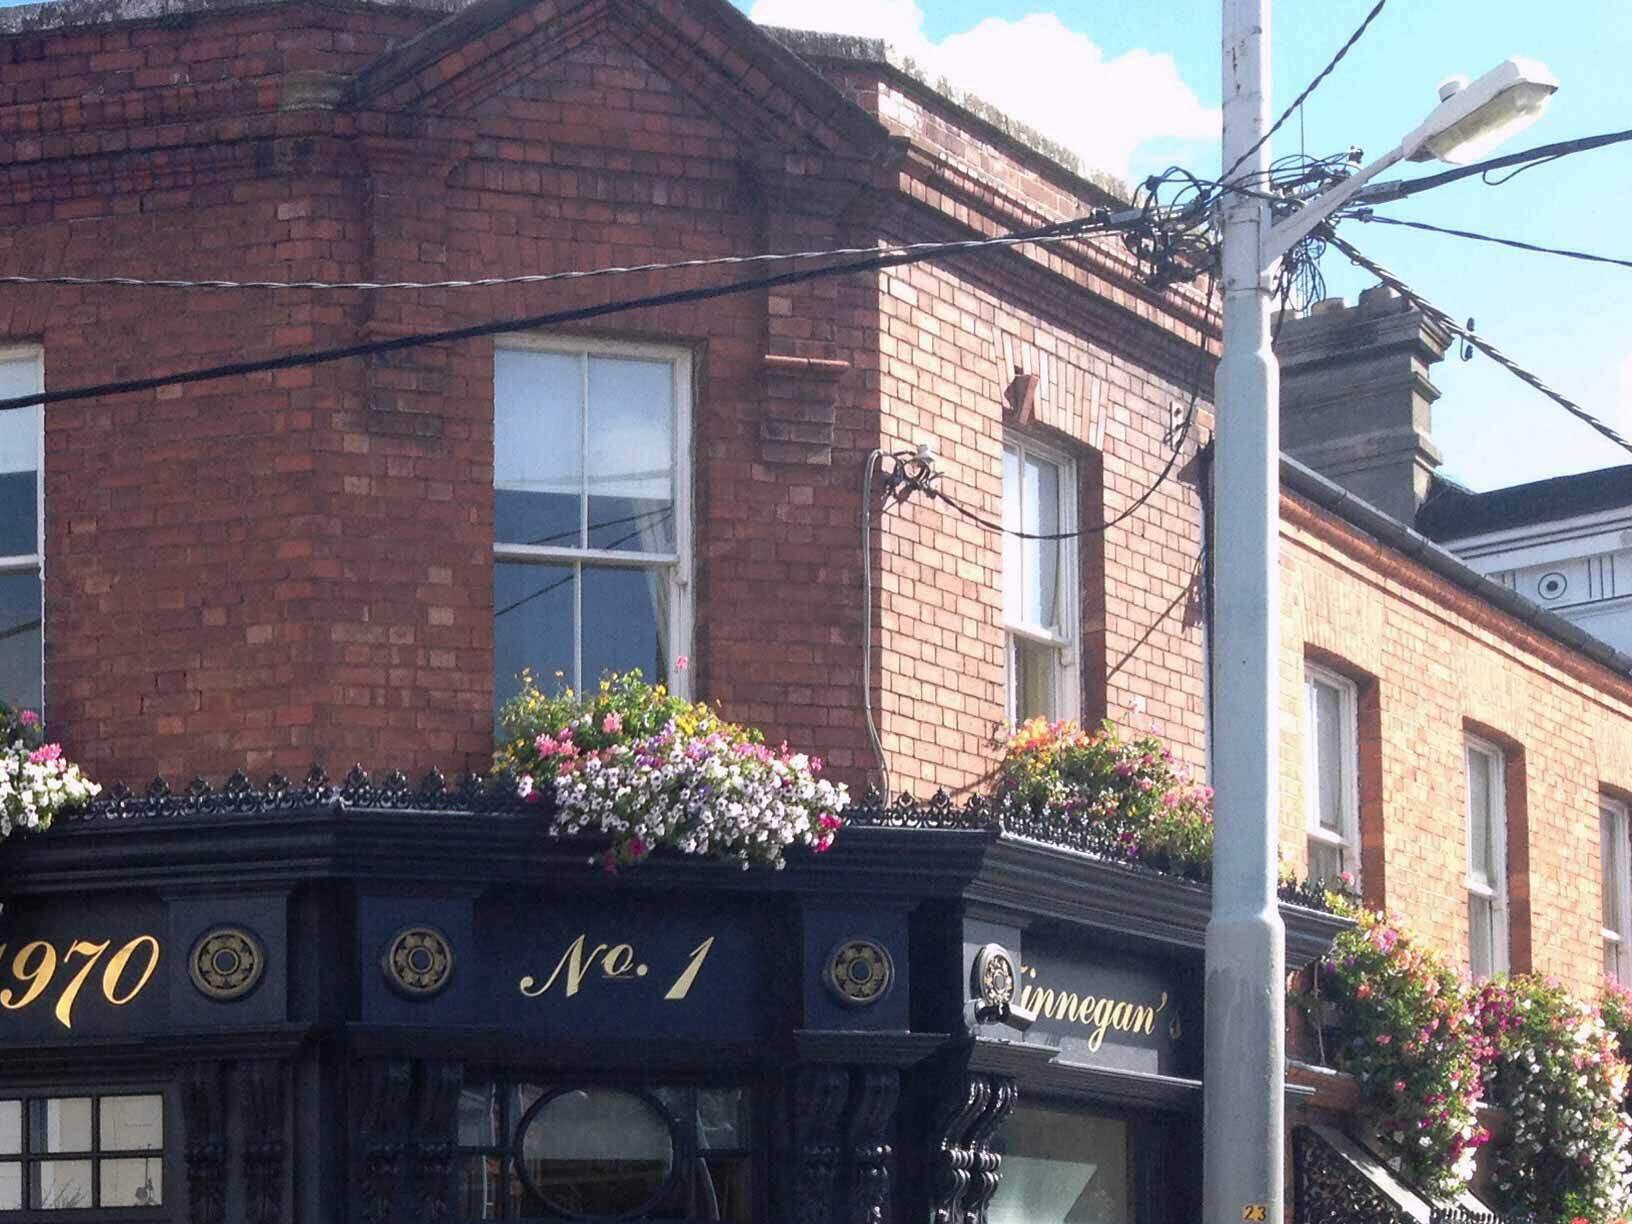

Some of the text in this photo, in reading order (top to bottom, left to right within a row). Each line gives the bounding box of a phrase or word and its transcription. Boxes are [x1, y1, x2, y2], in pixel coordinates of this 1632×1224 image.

[520, 934, 715, 1000] No. 1
[1020, 964, 1183, 1053] innegan's
[1244, 1205, 1267, 1222] 23
